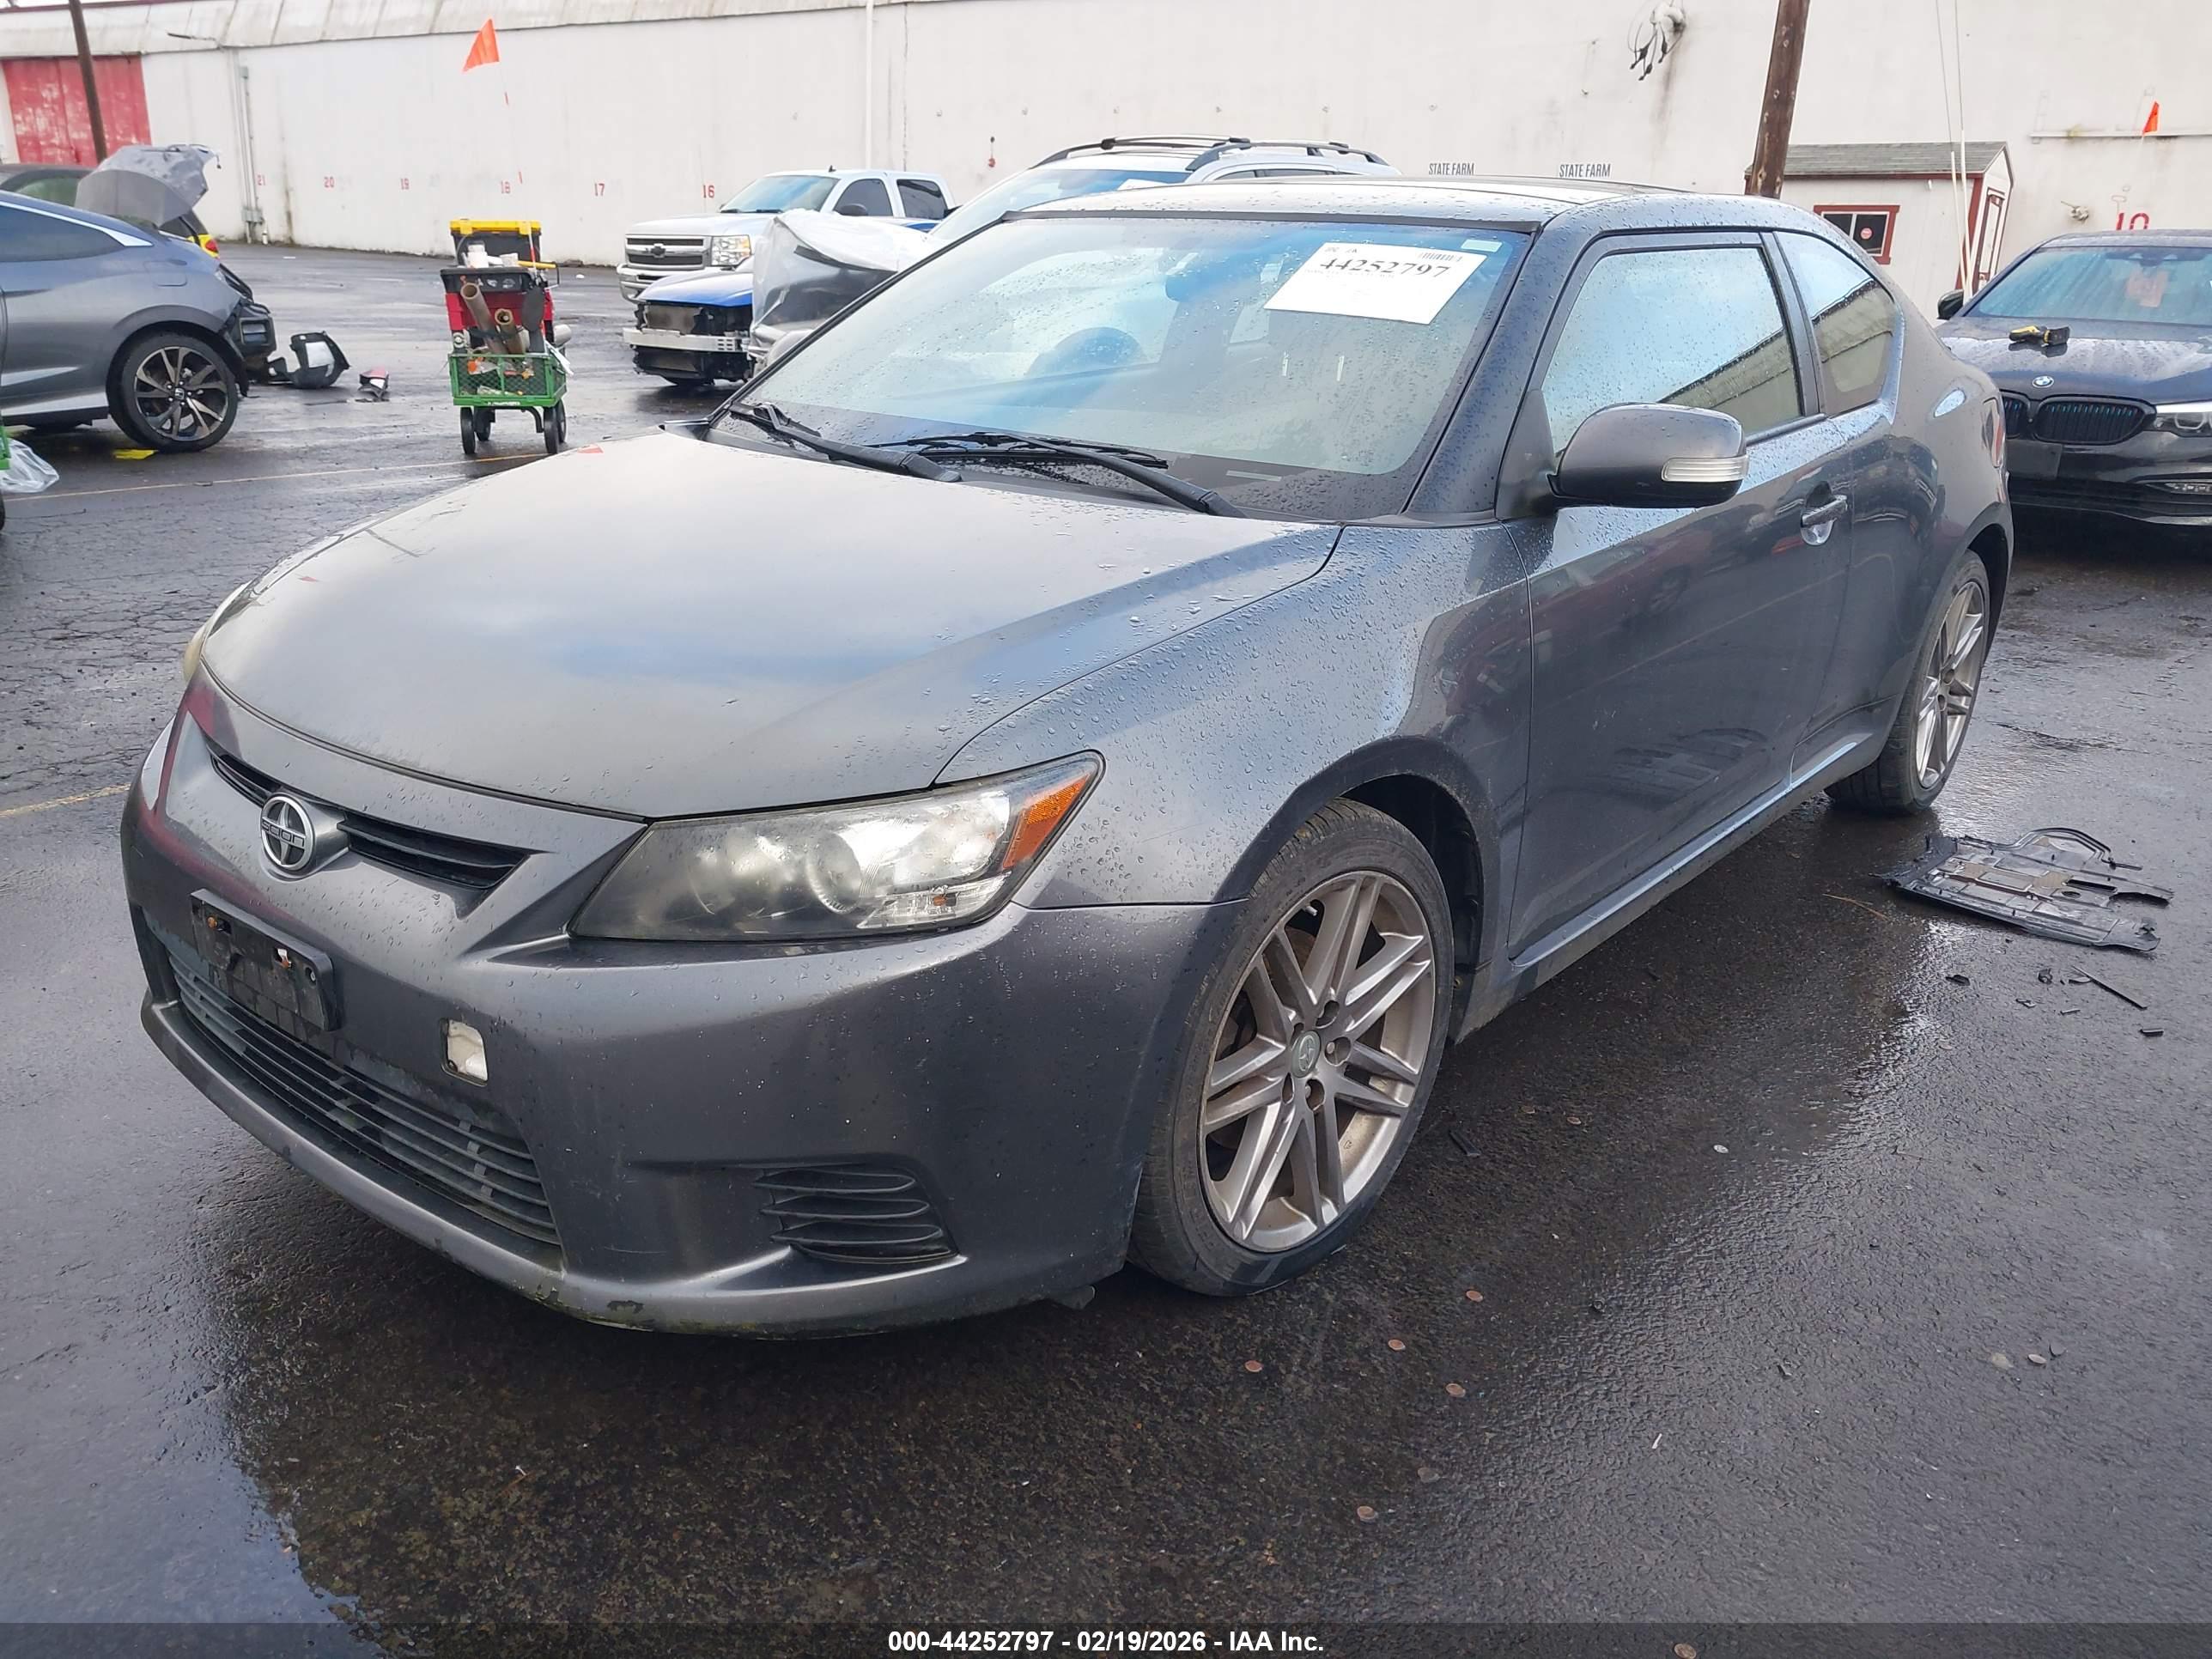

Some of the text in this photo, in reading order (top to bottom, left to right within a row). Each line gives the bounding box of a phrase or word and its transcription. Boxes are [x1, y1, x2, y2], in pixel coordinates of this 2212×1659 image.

[1429, 163, 1474, 175] STATE FARM
[1559, 164, 1611, 178] STATE FARM
[324, 176, 335, 188] 20
[594, 183, 605, 197] 17
[702, 185, 715, 198] 16
[1321, 258, 1450, 278] 44252797
